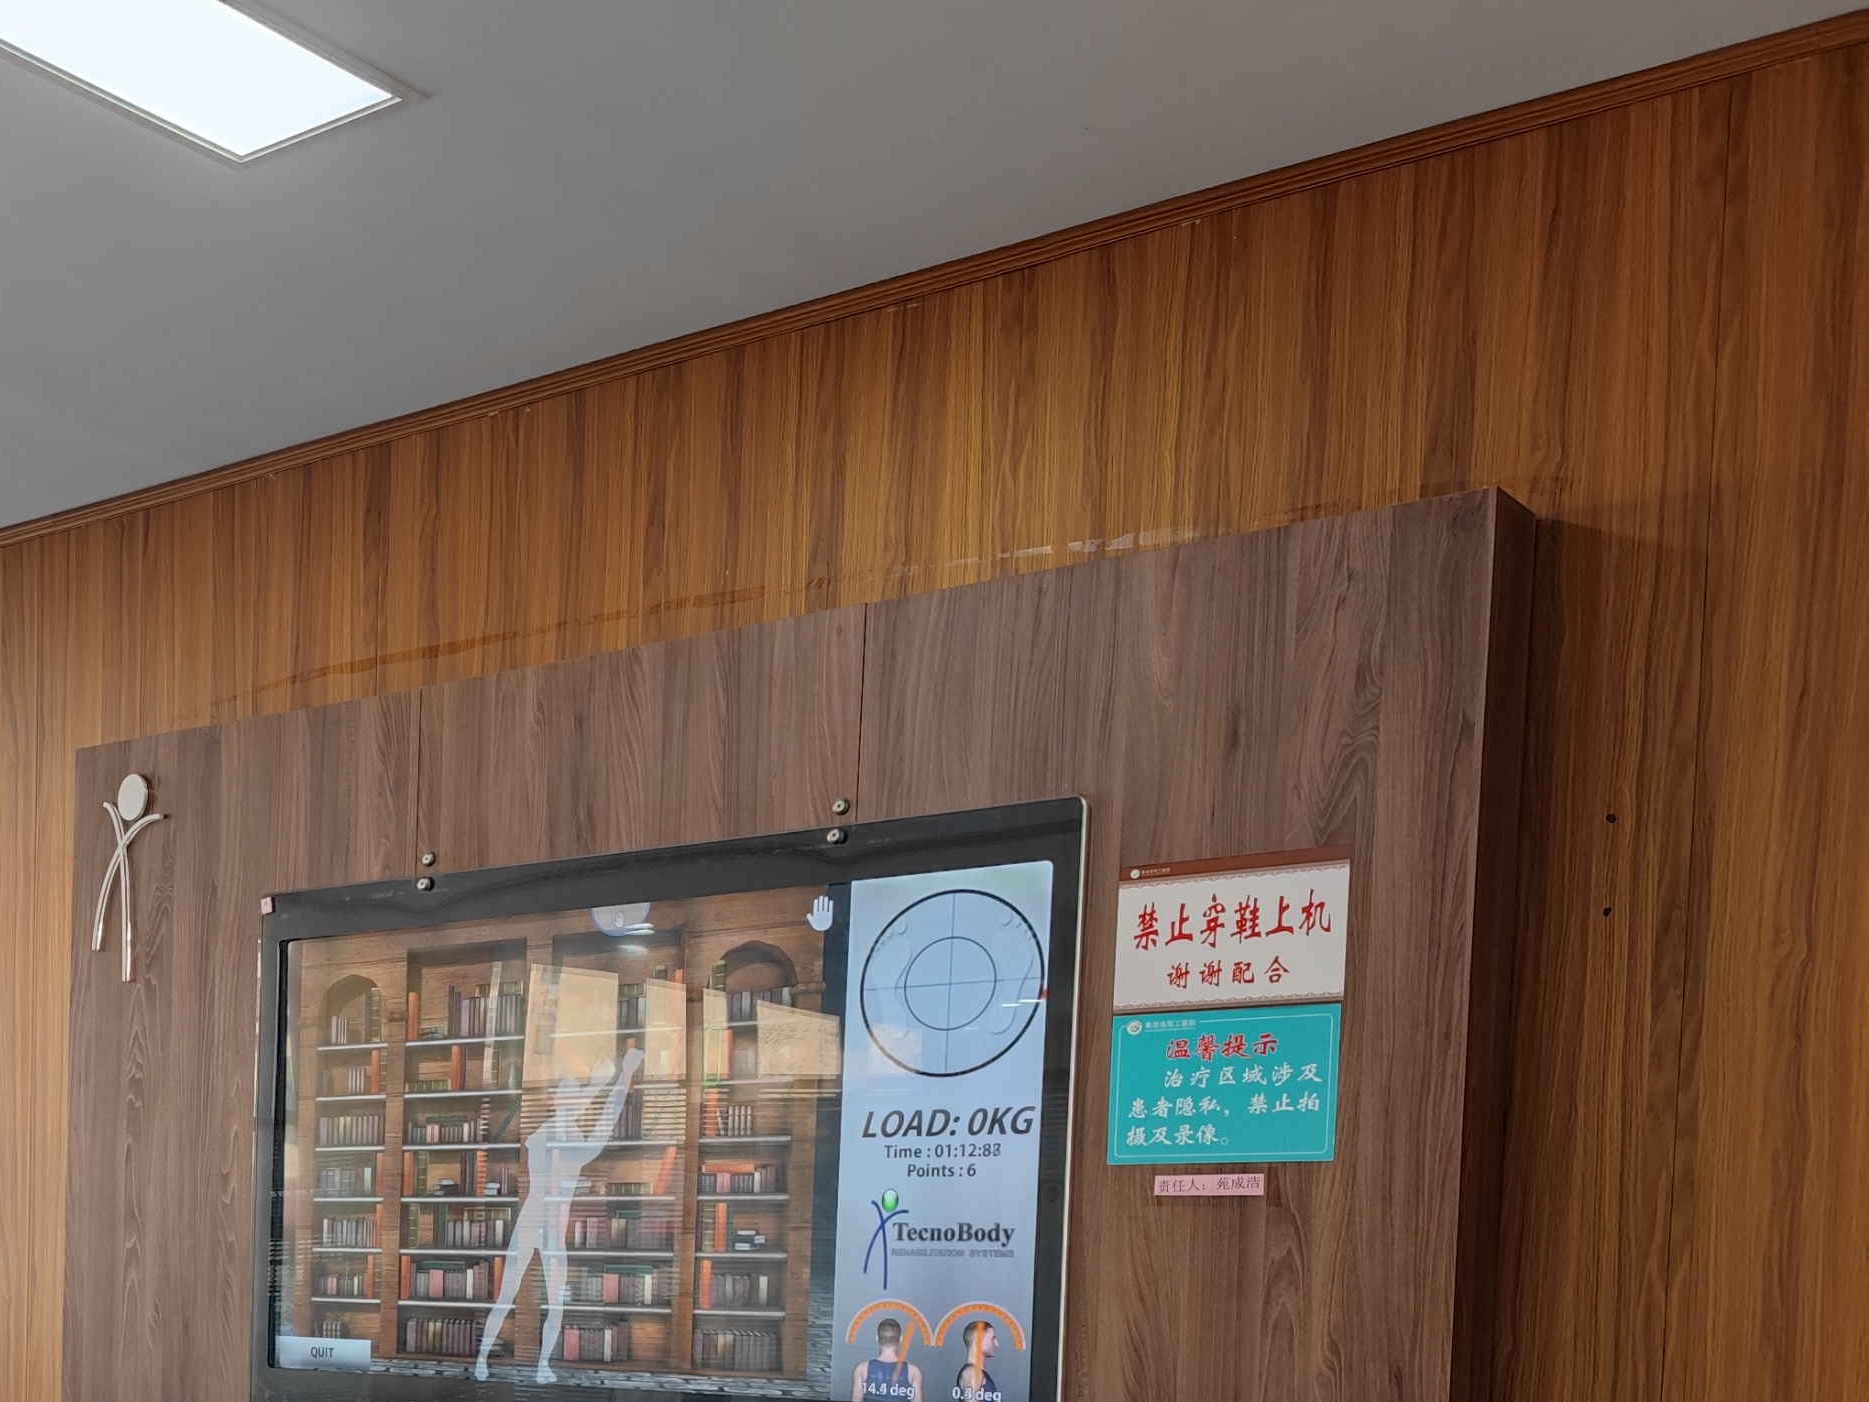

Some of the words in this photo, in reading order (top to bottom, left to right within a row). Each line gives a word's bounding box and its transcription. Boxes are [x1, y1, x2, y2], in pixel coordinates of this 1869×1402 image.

[1133, 888, 1332, 951] 禁止穿鞋上机
[1166, 955, 1290, 989] 谢谢配合
[1166, 1032, 1279, 1062] 温馨提示
[1163, 1061, 1323, 1089] 治疗区域涉及
[862, 1109, 961, 1138] LOAD:
[1125, 1123, 1230, 1148] 摄及录像。
[884, 1144, 923, 1159] Time
[907, 1163, 955, 1178] Points
[966, 1163, 977, 1177] 6
[892, 1222, 1016, 1247] TecnoBody
[969, 1249, 1015, 1258] SYSTEMS
[310, 1346, 335, 1358] QUIT
[890, 1383, 915, 1400] deg
